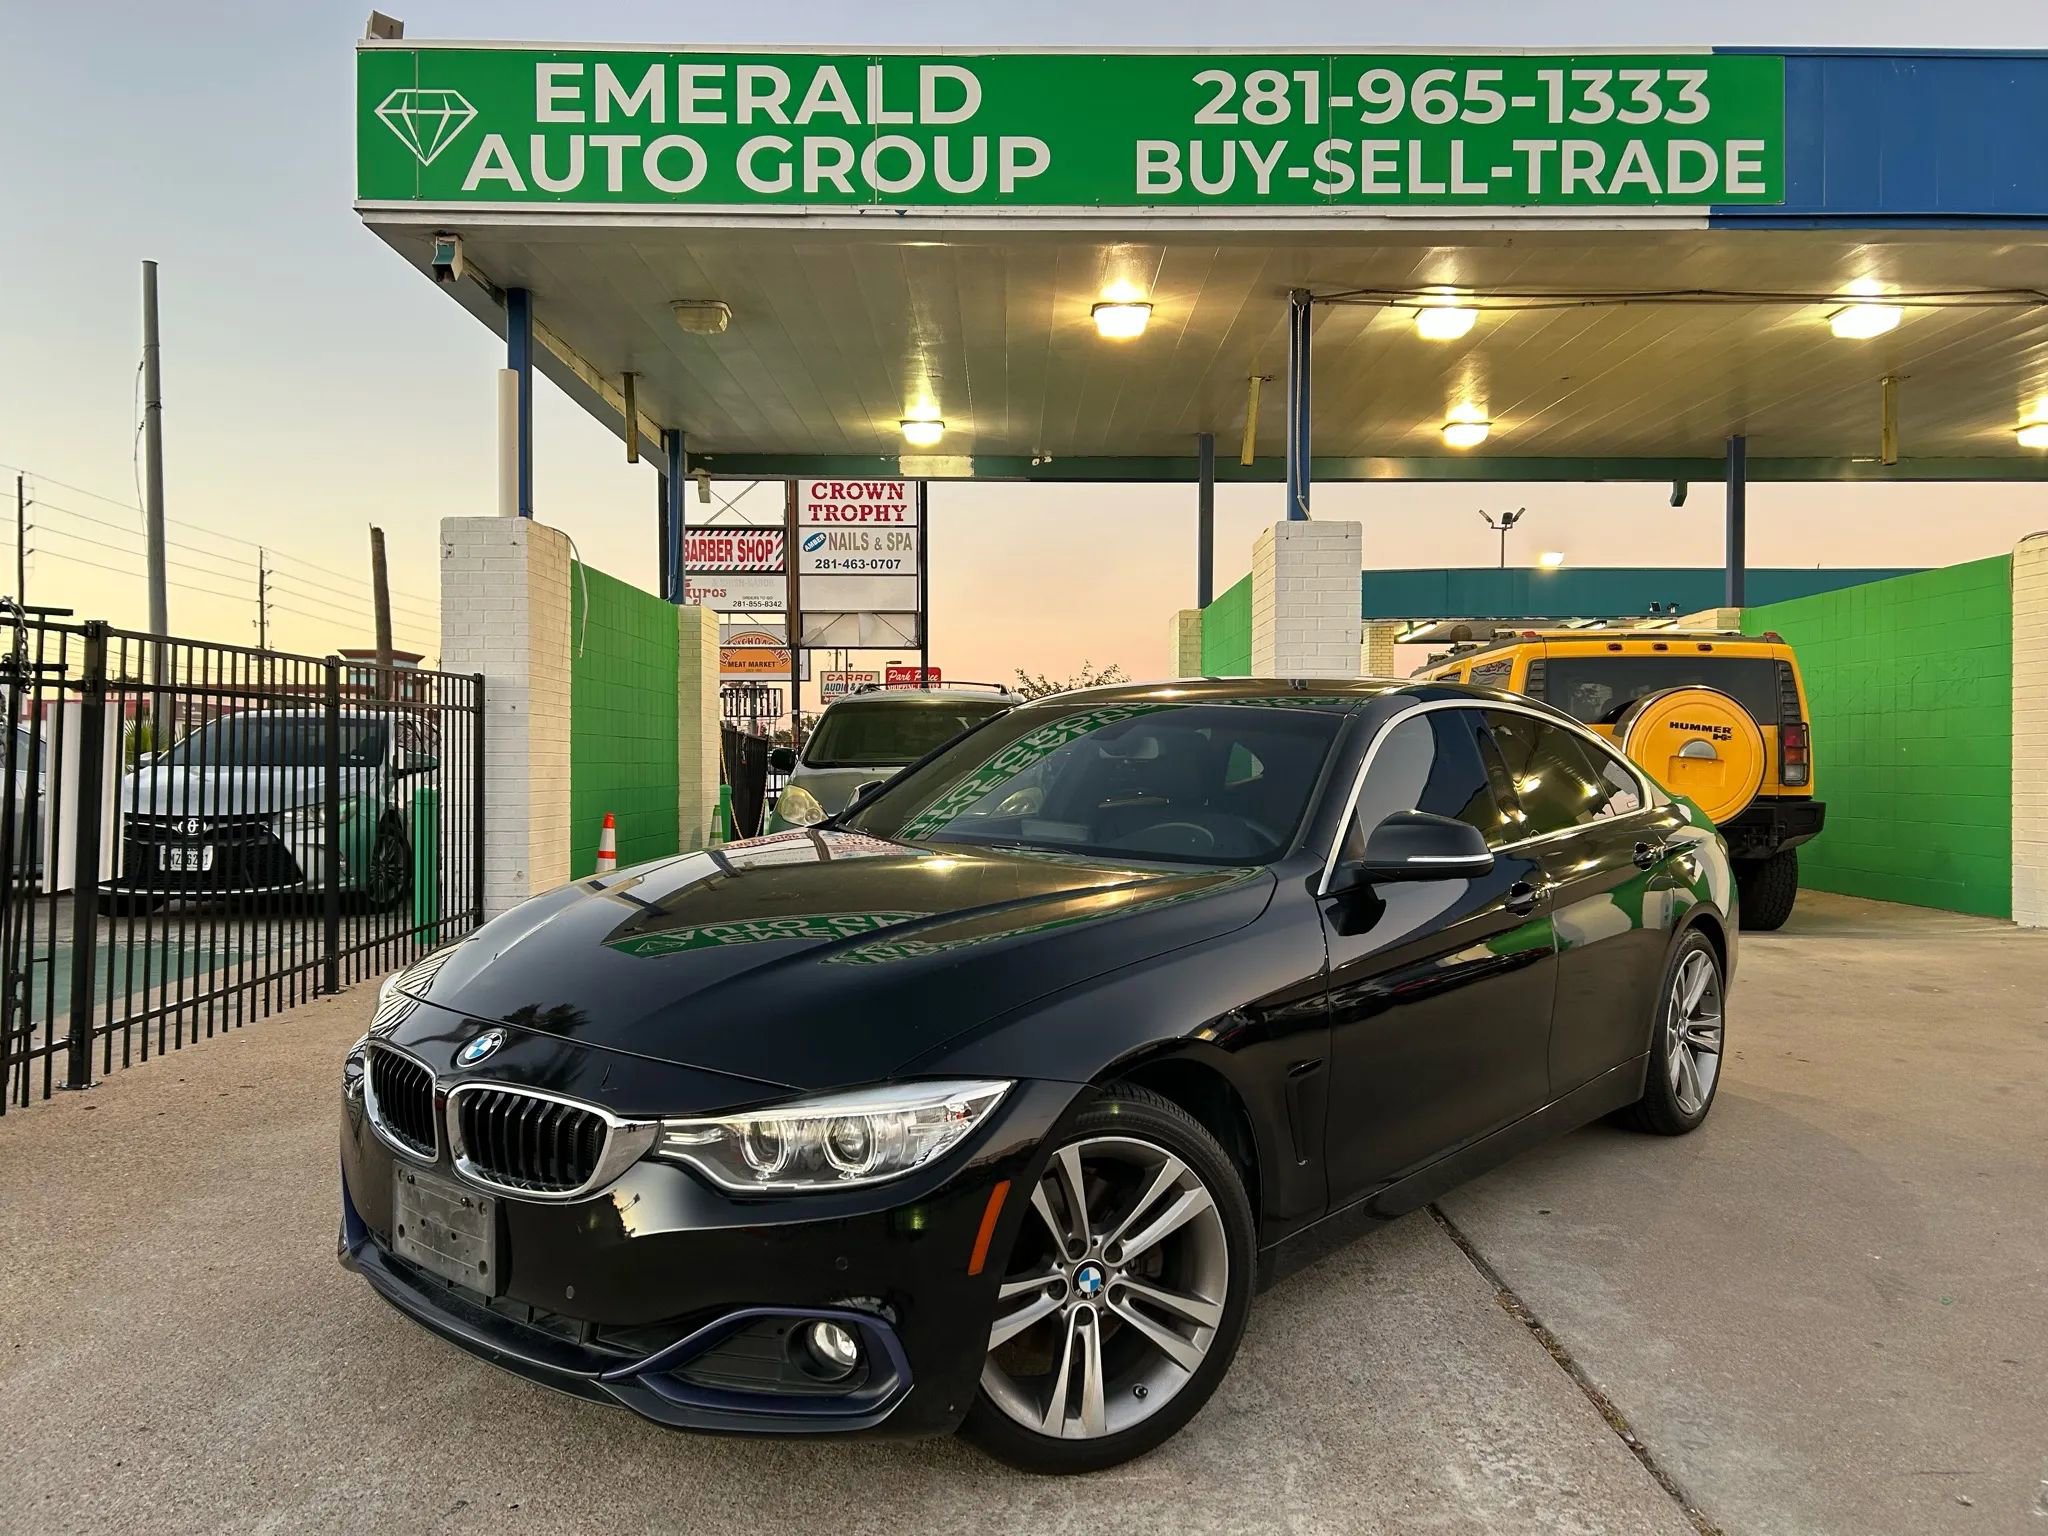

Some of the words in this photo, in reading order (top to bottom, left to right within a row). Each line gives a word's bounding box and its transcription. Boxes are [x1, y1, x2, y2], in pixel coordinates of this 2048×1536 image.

[535, 61, 982, 125] EMERALD
[1192, 68, 1711, 125] 281-965-1333
[461, 133, 708, 193] AUTO
[736, 134, 1051, 194] GROUP
[1135, 138, 1766, 195] BUY-SELL-TRADE
[811, 482, 905, 500] CROWN
[808, 504, 907, 522] TROPHY
[685, 539, 733, 562] BARBER
[737, 539, 774, 562] SHOP
[804, 533, 827, 552] AMBER
[828, 532, 869, 551] NAILS
[875, 537, 882, 550] &
[887, 532, 912, 551] SPA
[815, 558, 901, 570] 281-463-0707
[826, 674, 873, 682] CARRO
[888, 670, 912, 682] Park
[1671, 723, 1732, 734] HUMMER
